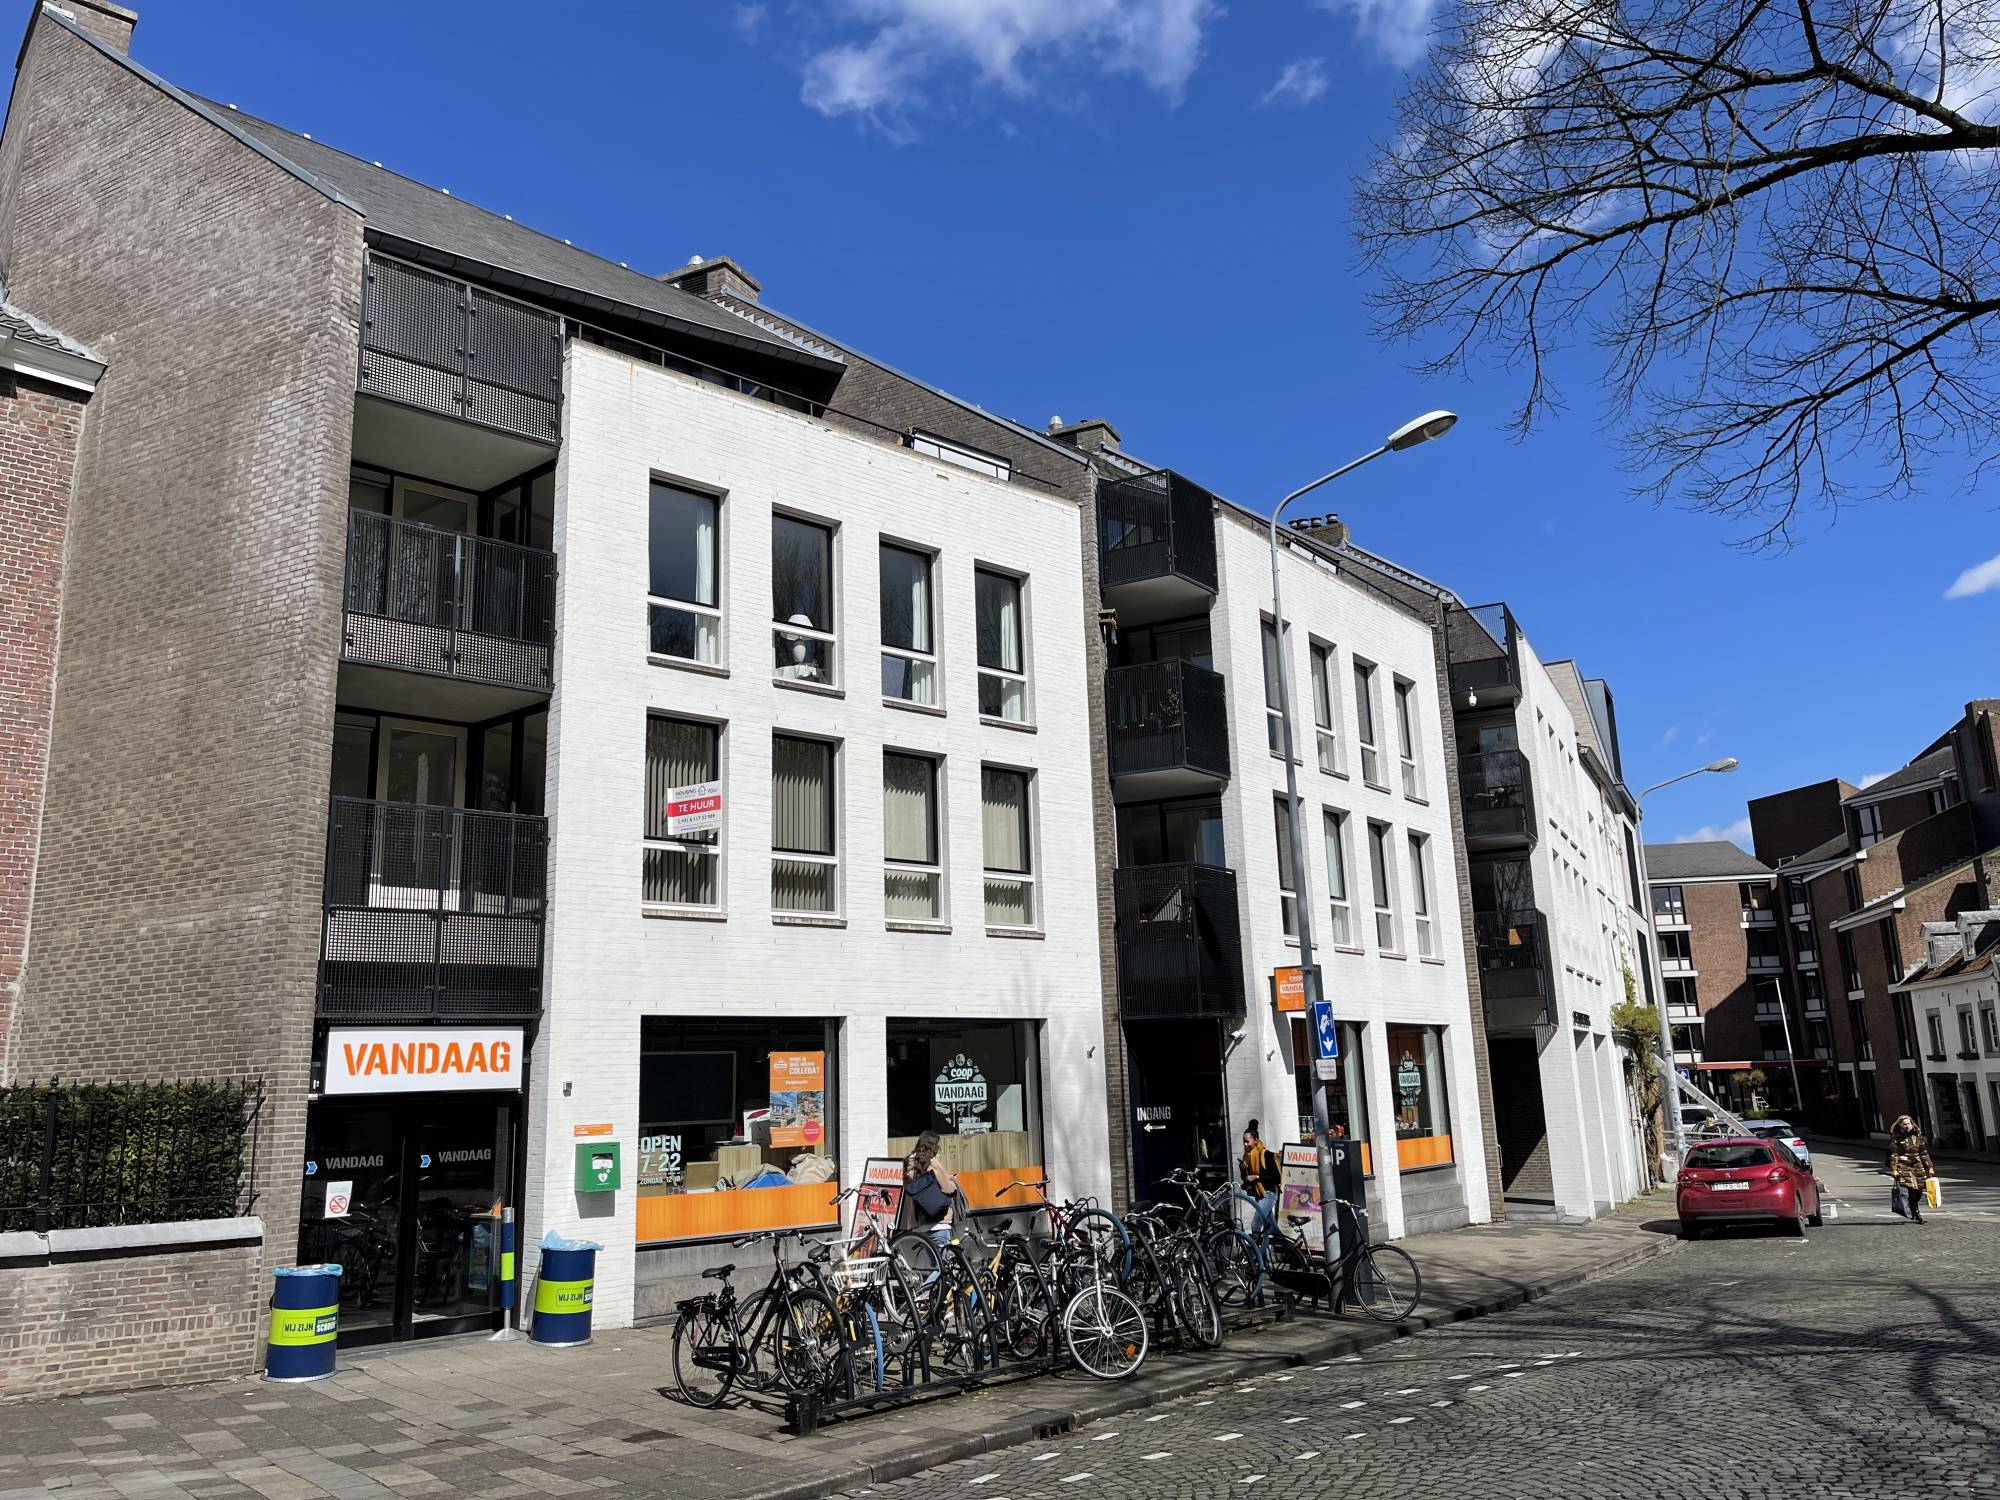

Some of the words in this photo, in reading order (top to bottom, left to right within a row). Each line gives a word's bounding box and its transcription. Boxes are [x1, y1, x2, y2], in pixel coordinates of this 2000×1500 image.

[678, 804, 688, 813] TE
[690, 800, 715, 811] HUUR
[1281, 984, 1304, 993] VANDA
[343, 1041, 511, 1076] VANDAAG
[950, 1067, 973, 1080] coop
[937, 1086, 984, 1099] VANDAAG
[1136, 1105, 1172, 1122] INGANG
[640, 1135, 682, 1153] OPEN
[325, 1154, 384, 1170] VANDAAG
[438, 1149, 492, 1163] VANDAAG
[640, 1152, 681, 1173] 7-22
[1287, 1150, 1318, 1162] VANDA
[1335, 1149, 1345, 1165] P
[284, 1323, 297, 1332] WIJ
[297, 1322, 314, 1332] ZIJN
